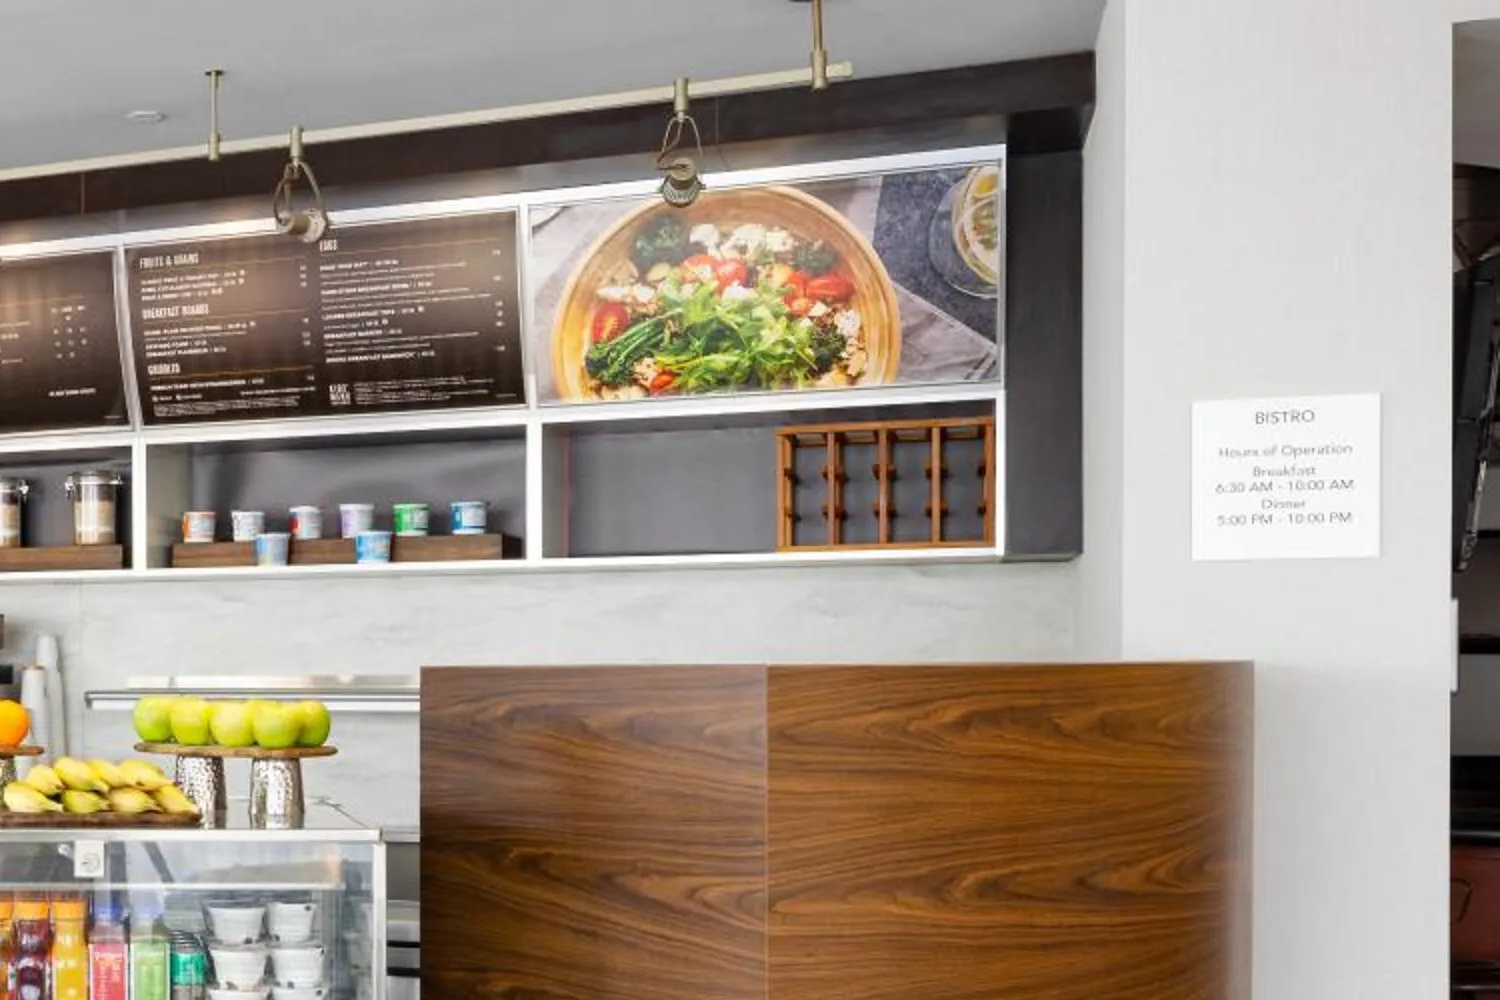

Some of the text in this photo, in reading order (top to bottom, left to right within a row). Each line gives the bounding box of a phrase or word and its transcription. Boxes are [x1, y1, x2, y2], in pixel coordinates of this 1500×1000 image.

[1255, 409, 1315, 425] BISTRO
[1219, 444, 1353, 460] Hours of Operation
[1252, 465, 1316, 477] Breakfast
[1215, 481, 1245, 494] 6:30
[1249, 481, 1273, 492] AM
[1289, 479, 1325, 491] 10:00
[1329, 479, 1354, 490] AM
[1261, 498, 1306, 509] Dinner
[1251, 513, 1273, 525] PM
[1289, 512, 1325, 524] 10:00
[1329, 511, 1352, 523] PM
